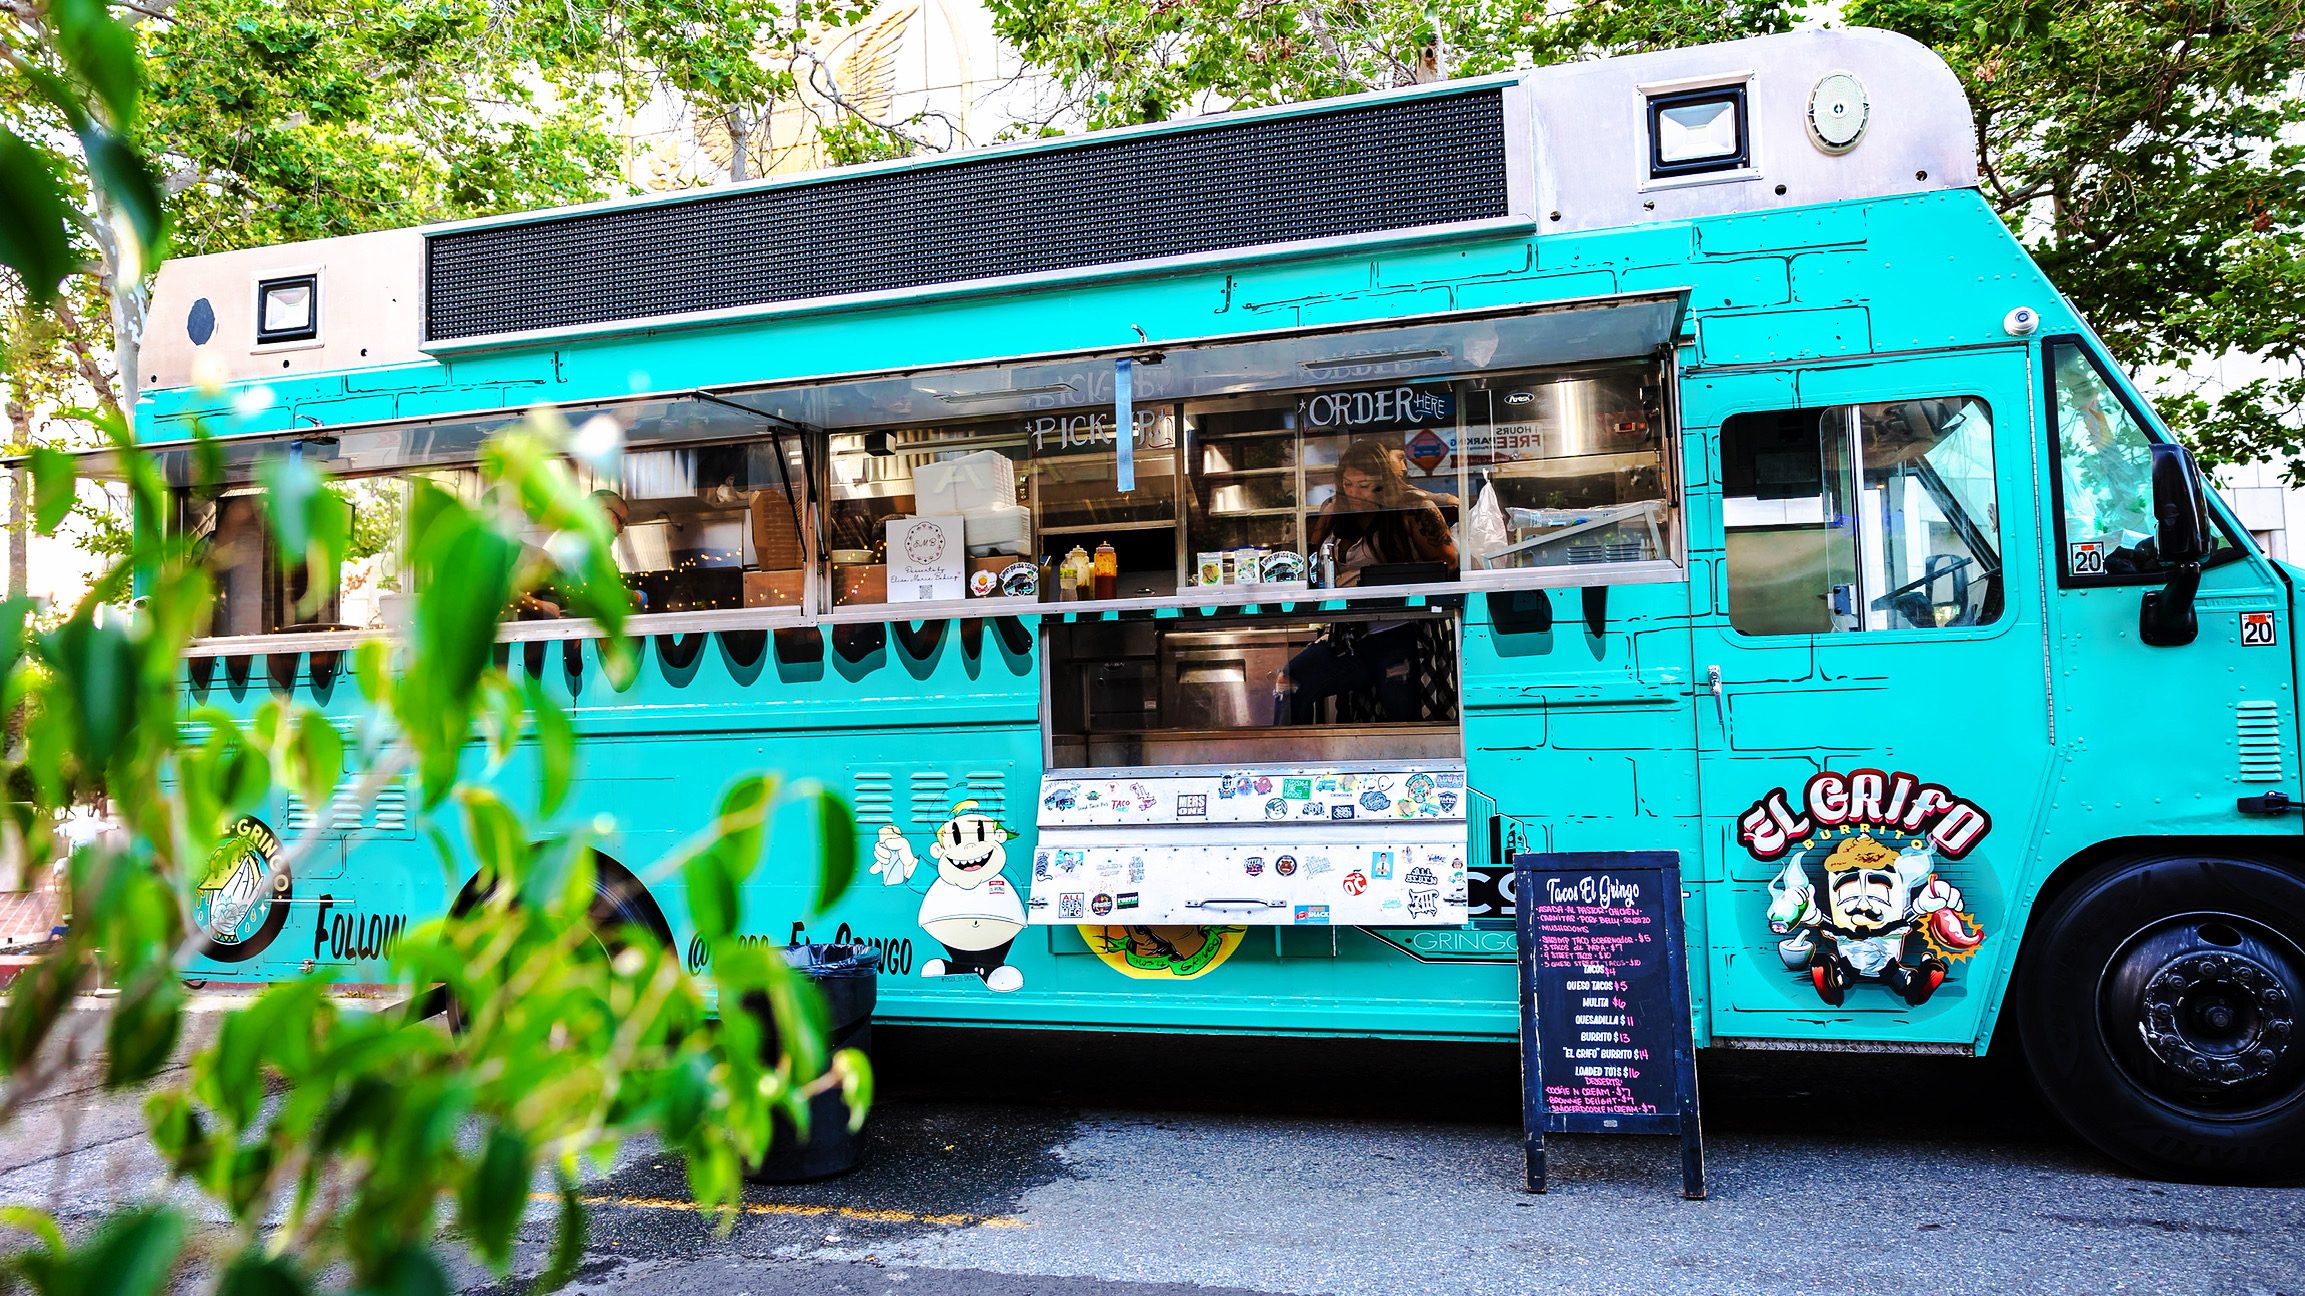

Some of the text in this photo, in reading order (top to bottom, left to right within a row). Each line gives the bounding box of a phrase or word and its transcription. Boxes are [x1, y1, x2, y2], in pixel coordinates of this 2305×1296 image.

[1309, 387, 1446, 426] ORDER HERE
[1031, 413, 1112, 452] PICK
[2075, 551, 2101, 573] 20
[2244, 621, 2272, 643] 20
[1111, 799, 1130, 810] TACO
[1178, 807, 1204, 815] ONE
[1743, 774, 1985, 856] EL GRIFO
[1802, 823, 1923, 851] BURRITO
[1546, 878, 1578, 904] Tacos
[1580, 876, 1596, 903] El
[1600, 875, 1639, 909] Gringo
[1061, 908, 1081, 917] MFG
[1638, 932, 1651, 943] $5
[1610, 944, 1623, 952] $7
[1583, 964, 1616, 977] TACOS $4
[1566, 980, 1628, 991] QUESO TACOS $5
[1583, 997, 1627, 1010] MULITA $6
[1575, 1015, 1619, 1025] QUESADILLA
[1580, 1031, 1612, 1042] BURRITO
[1563, 1047, 1575, 1058] "EL
[1576, 1047, 1600, 1058] GRIFO"
[1601, 1049, 1632, 1060] BURRITO
[1575, 1066, 1602, 1076] LOADED
[1604, 1066, 1622, 1076] TOTS
[1582, 1087, 1610, 1096] CREAM
[1616, 1086, 1630, 1097] $7
